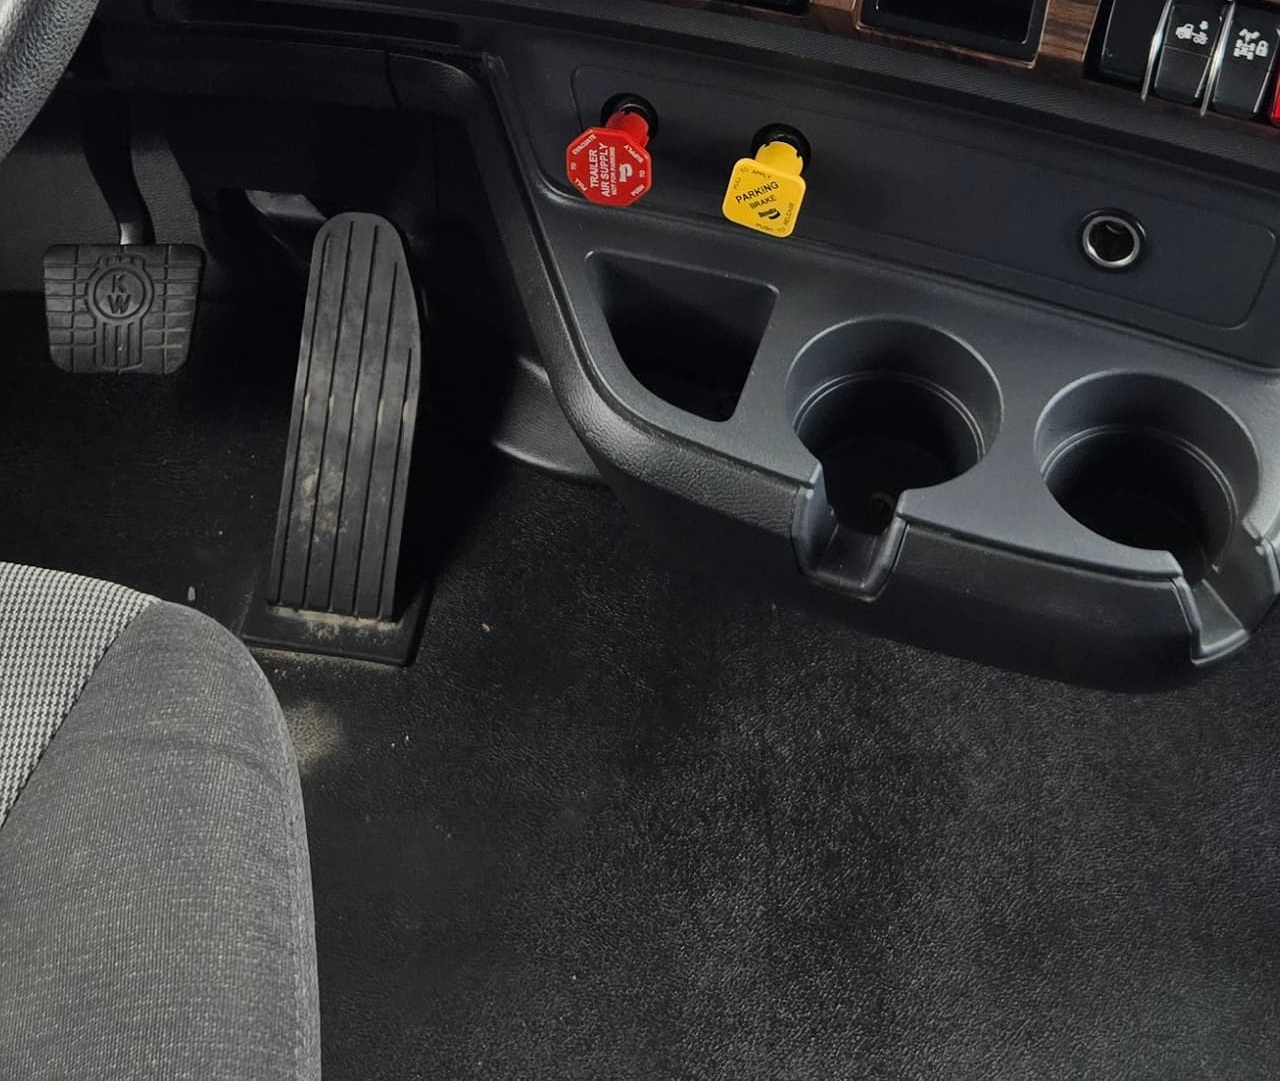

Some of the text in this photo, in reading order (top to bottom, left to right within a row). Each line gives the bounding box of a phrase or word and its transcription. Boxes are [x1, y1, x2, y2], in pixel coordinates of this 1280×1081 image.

[588, 149, 599, 188] TRAILER
[599, 142, 610, 197] AIR SUPPLY
[735, 181, 780, 204] PARKING
[749, 194, 777, 210] BRAKE
